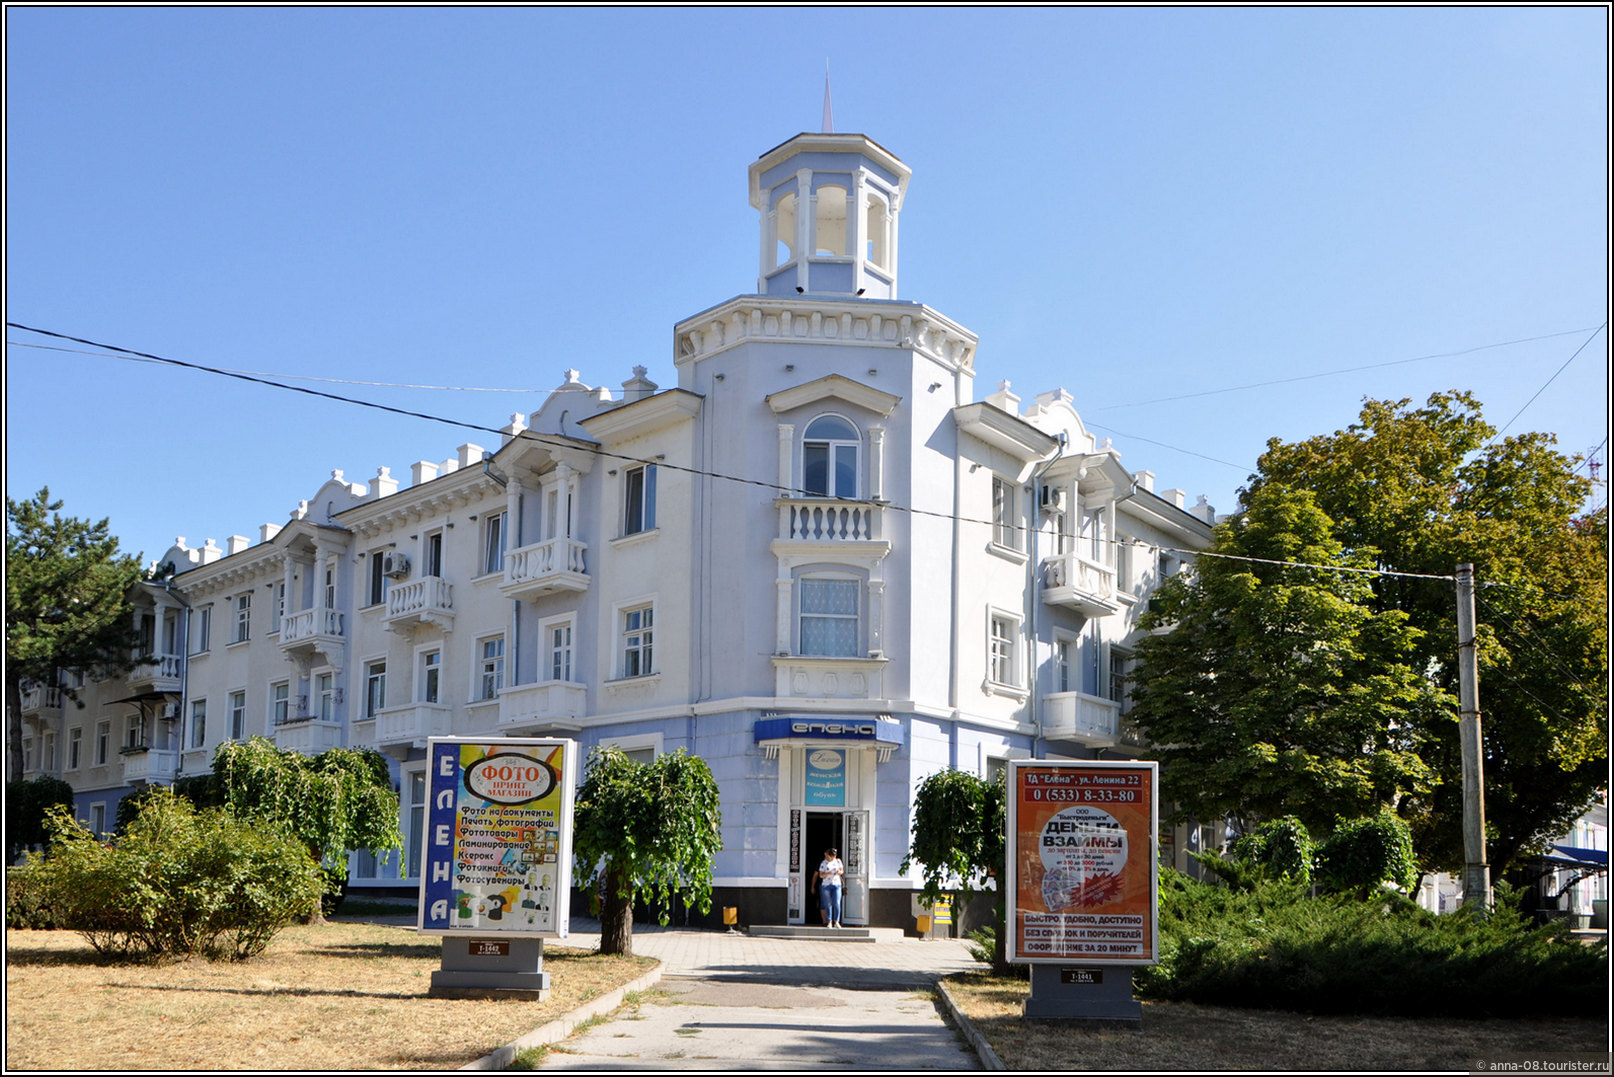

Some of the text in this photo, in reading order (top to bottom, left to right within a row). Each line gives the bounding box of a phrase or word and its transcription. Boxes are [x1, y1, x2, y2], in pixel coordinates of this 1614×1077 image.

[481, 765, 540, 782] ФОТО
[1027, 774, 1039, 784] ТД
[1079, 776, 1091, 785] ул.
[1092, 775, 1126, 785] Ленина
[1128, 776, 1139, 785] 22
[493, 781, 527, 789] ПРИНТ
[487, 789, 532, 797] МАГАЗИН
[1033, 789, 1135, 802] 0 (533) 8-33-80
[461, 806, 554, 818] Фото на документы
[461, 816, 554, 828] Печать фотографий
[460, 828, 518, 838] Фототовары
[1046, 822, 1119, 834] ДЕНЬГИ
[430, 755, 455, 921] ЕЛЕНА
[1043, 834, 1123, 848] ВЗАЙМЫ
[459, 839, 530, 849] Ламинирование
[458, 851, 494, 859] Ксерокс
[457, 863, 508, 872] Фотокниги
[456, 874, 525, 885] Фотосувениры
[1098, 916, 1142, 925] ДОСТУПНО
[1087, 930, 1142, 938] ПОРУЧИТЕЛЕЙ
[1085, 944, 1096, 952] ЗА
[1097, 944, 1108, 952] 20
[1109, 944, 1138, 953] МИНУТ
